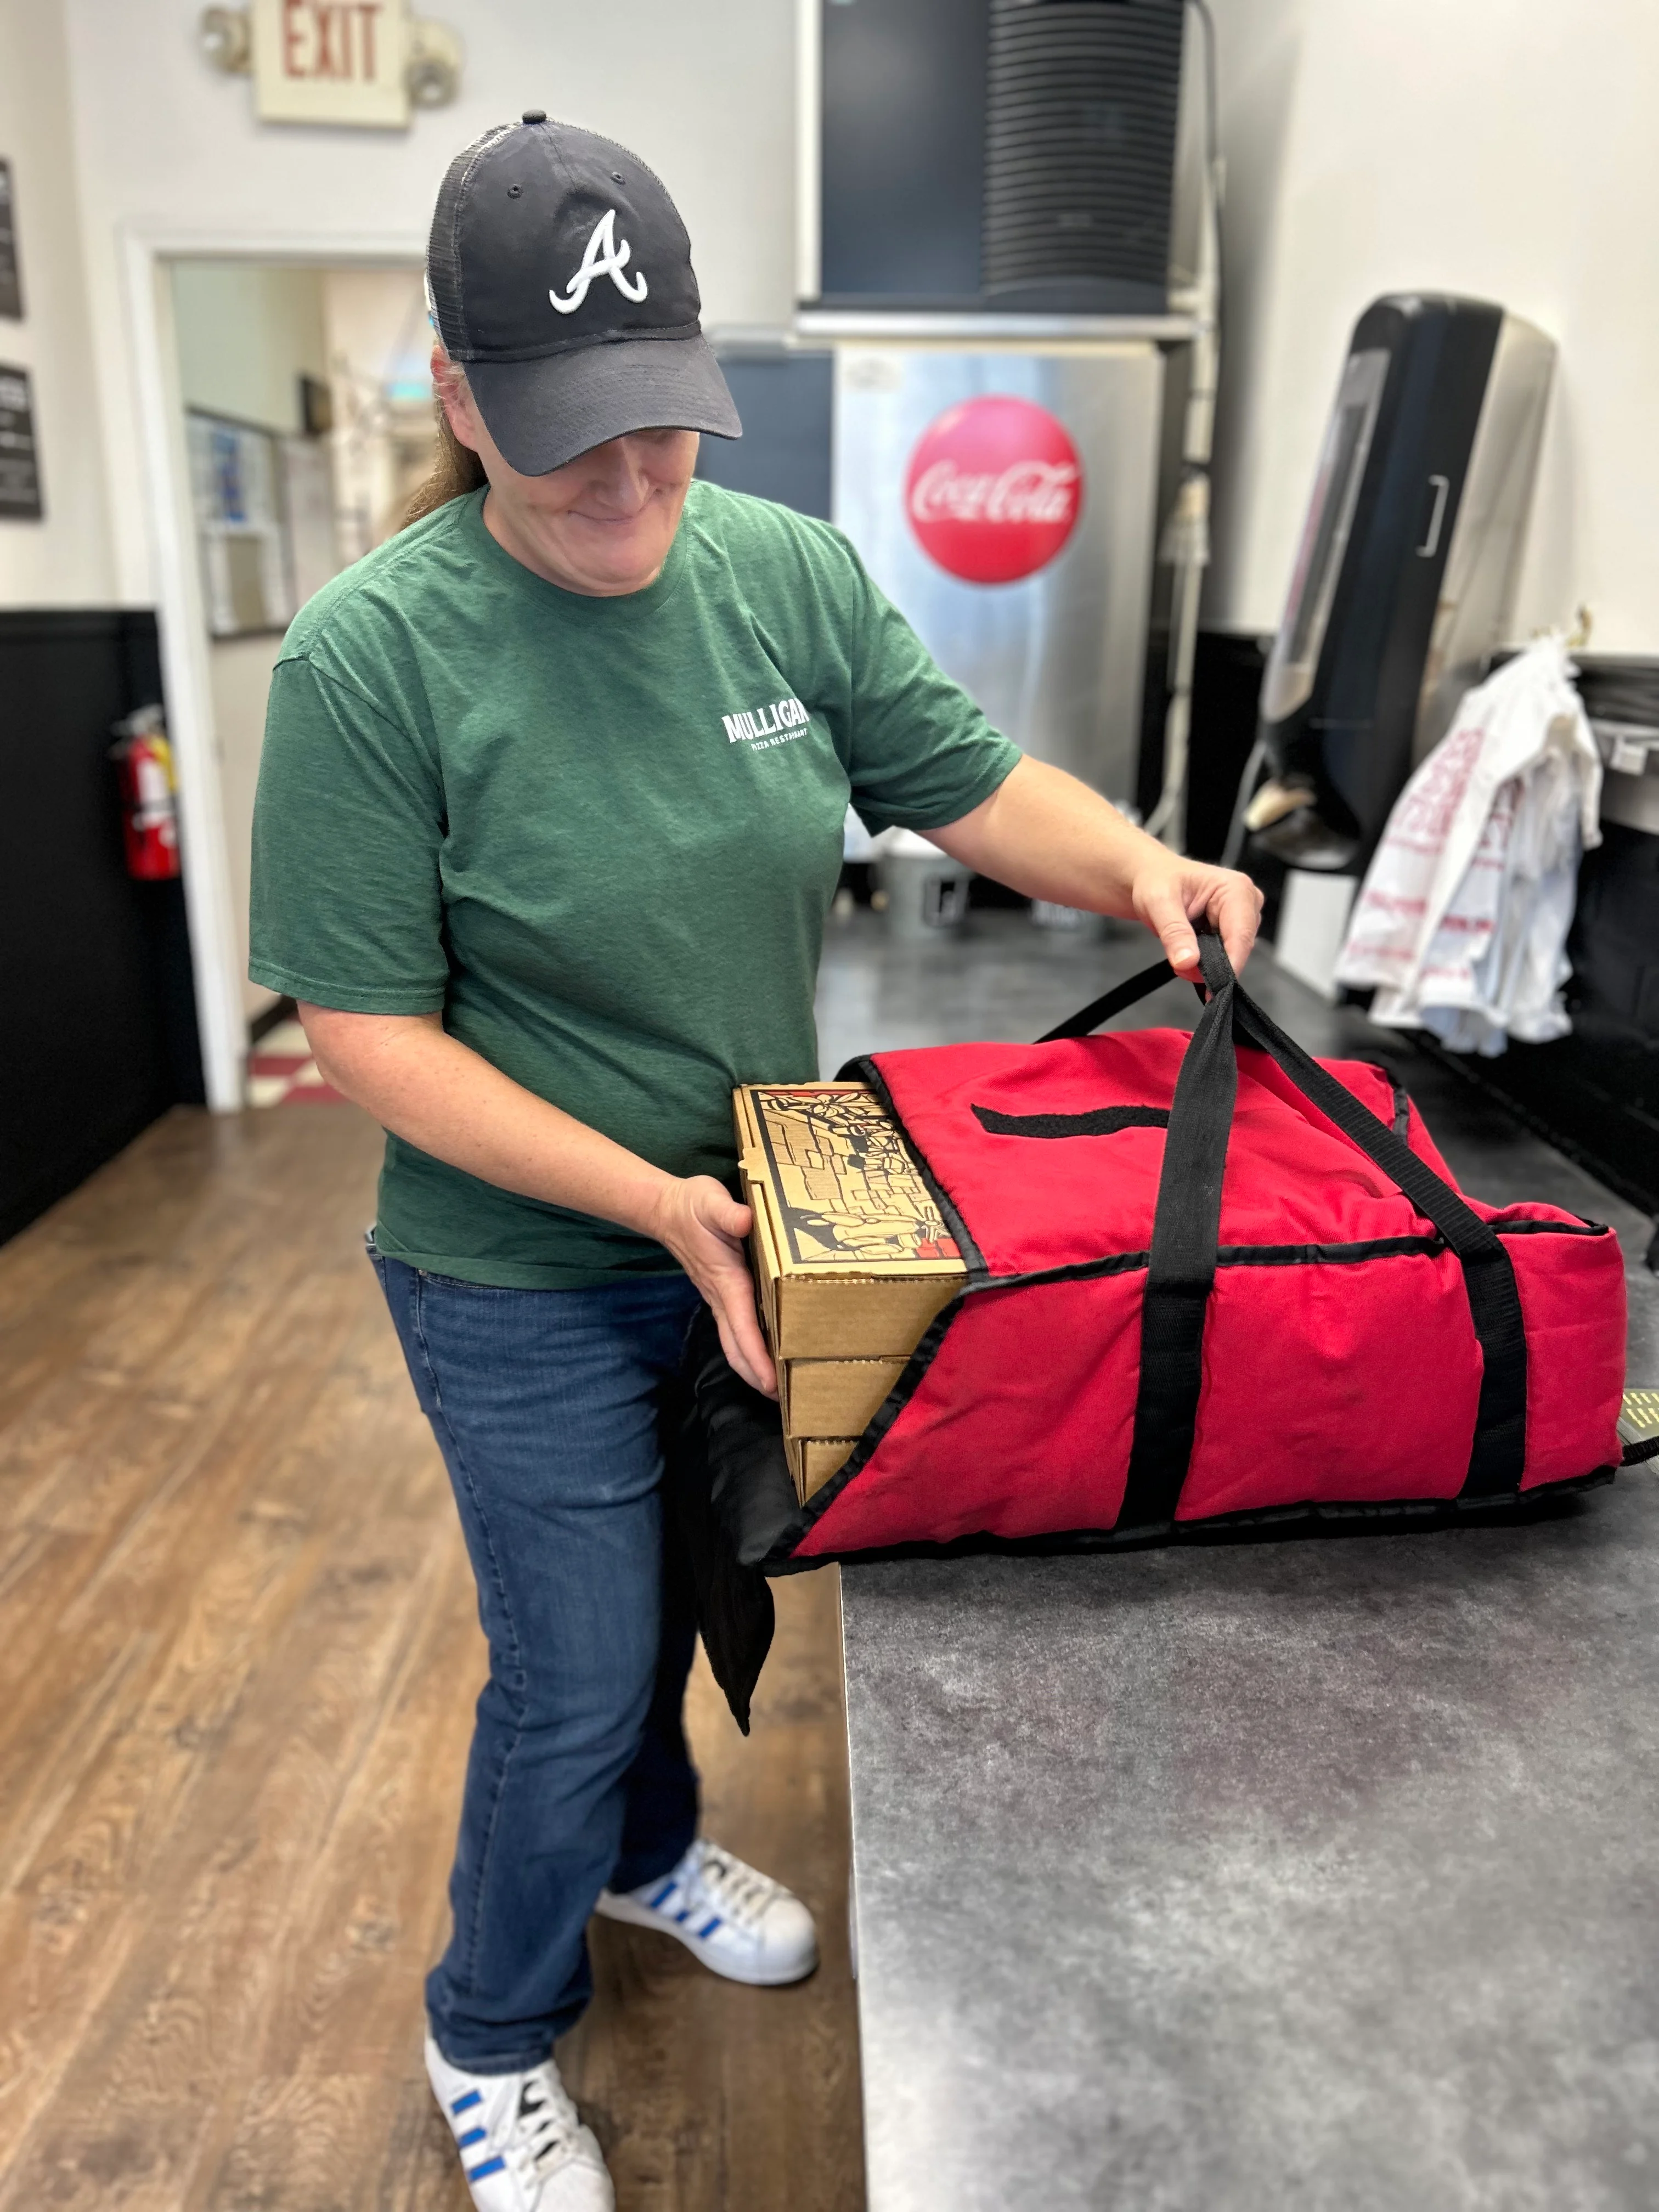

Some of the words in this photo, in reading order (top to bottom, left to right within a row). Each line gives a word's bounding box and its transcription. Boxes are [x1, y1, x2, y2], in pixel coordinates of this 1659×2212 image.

[283, 0, 383, 82] EXIT
[549, 209, 648, 314] A
[751, 741, 769, 751] PIZZA
[770, 728, 808, 746] RESTAURANT
